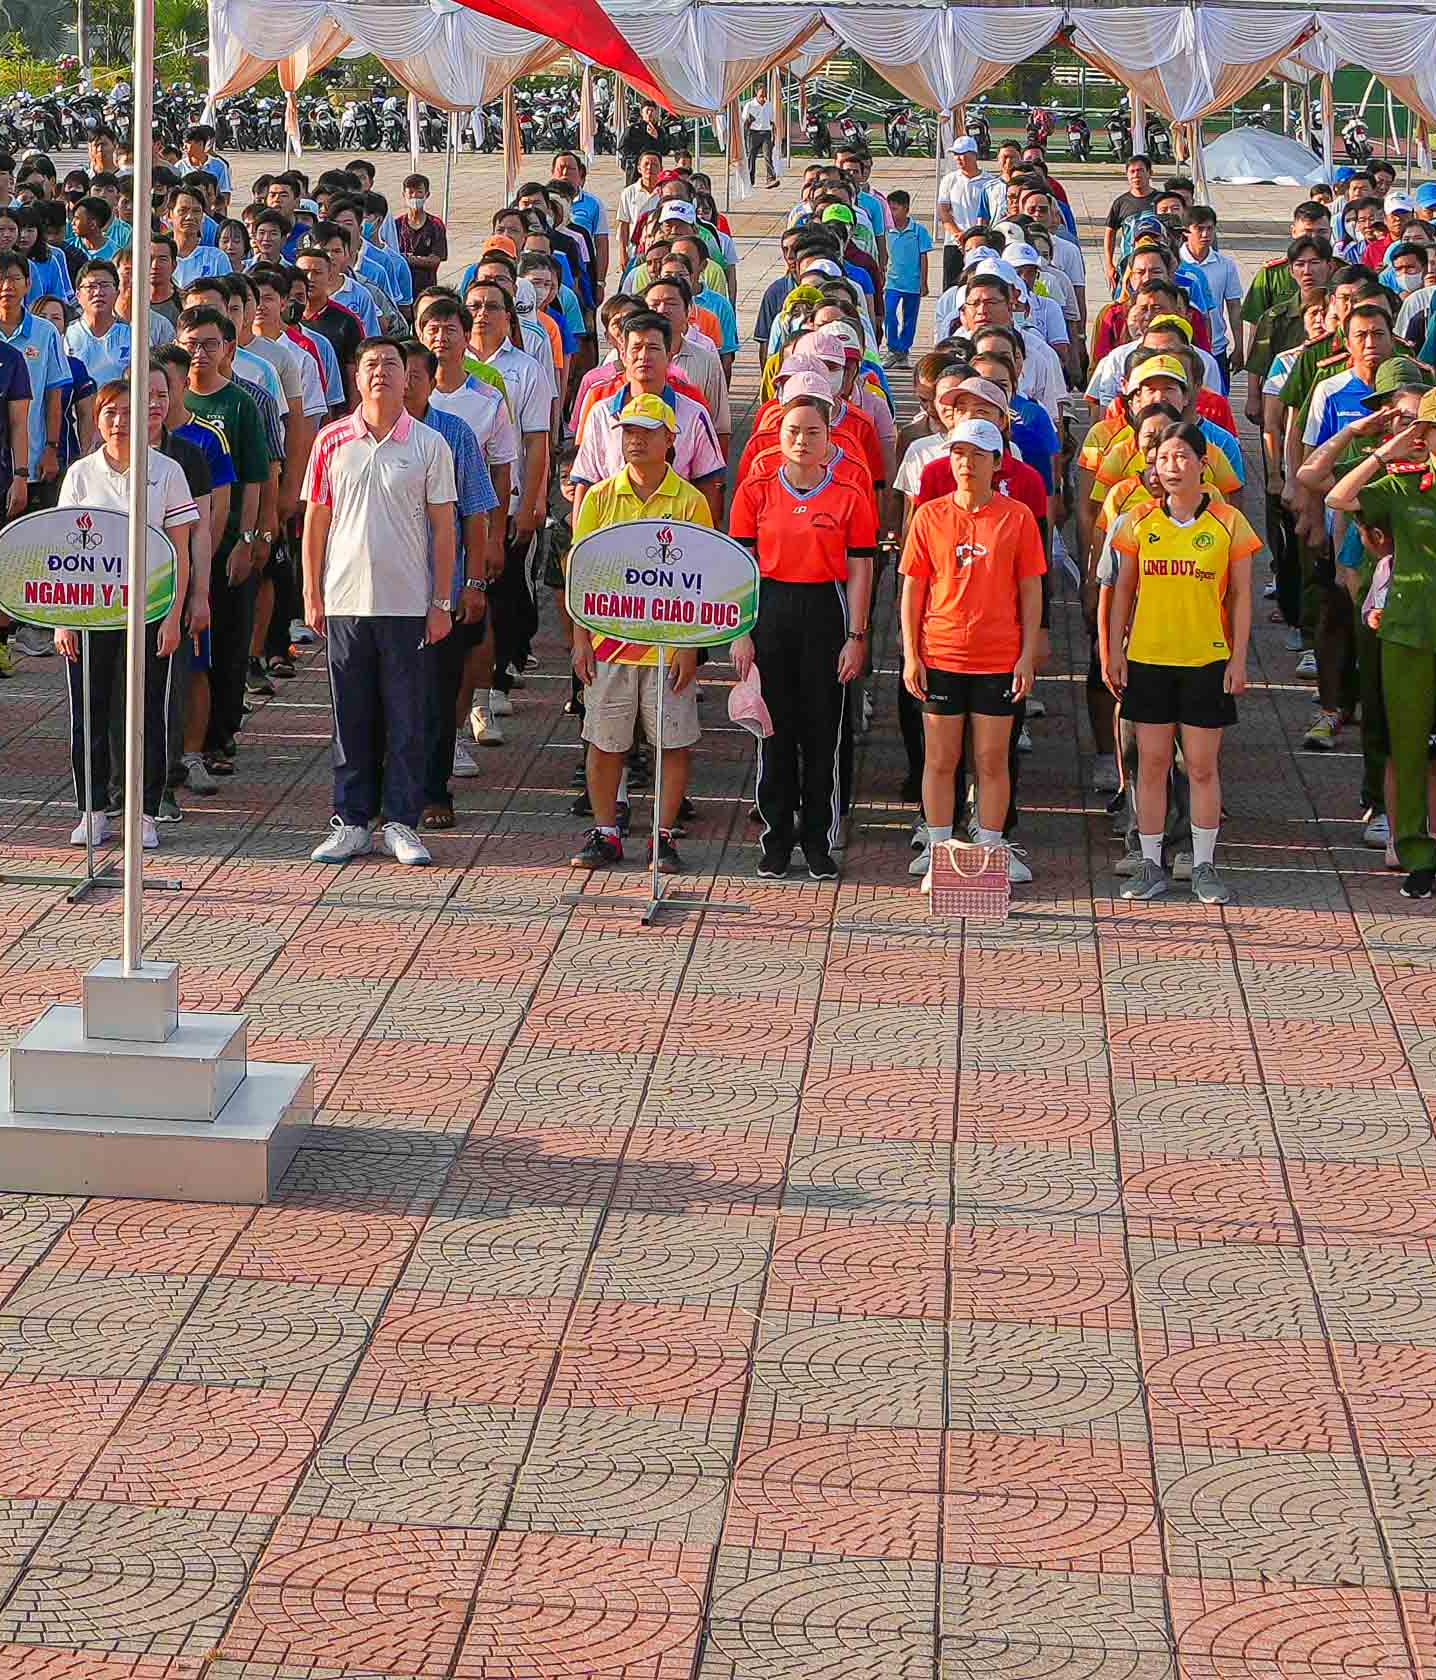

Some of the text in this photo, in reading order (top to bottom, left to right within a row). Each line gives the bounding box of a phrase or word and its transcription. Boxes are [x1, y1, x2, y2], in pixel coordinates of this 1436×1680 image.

[48, 553, 122, 578] ĐƠN VỊ
[1143, 559, 1168, 576] LINH
[1171, 559, 1196, 576] DUY
[24, 579, 95, 606] NGÀNH
[102, 583, 117, 607] Y
[625, 567, 703, 595] ĐƠN VỊ
[584, 591, 740, 630] NGÀNH GIÁO DỤC
